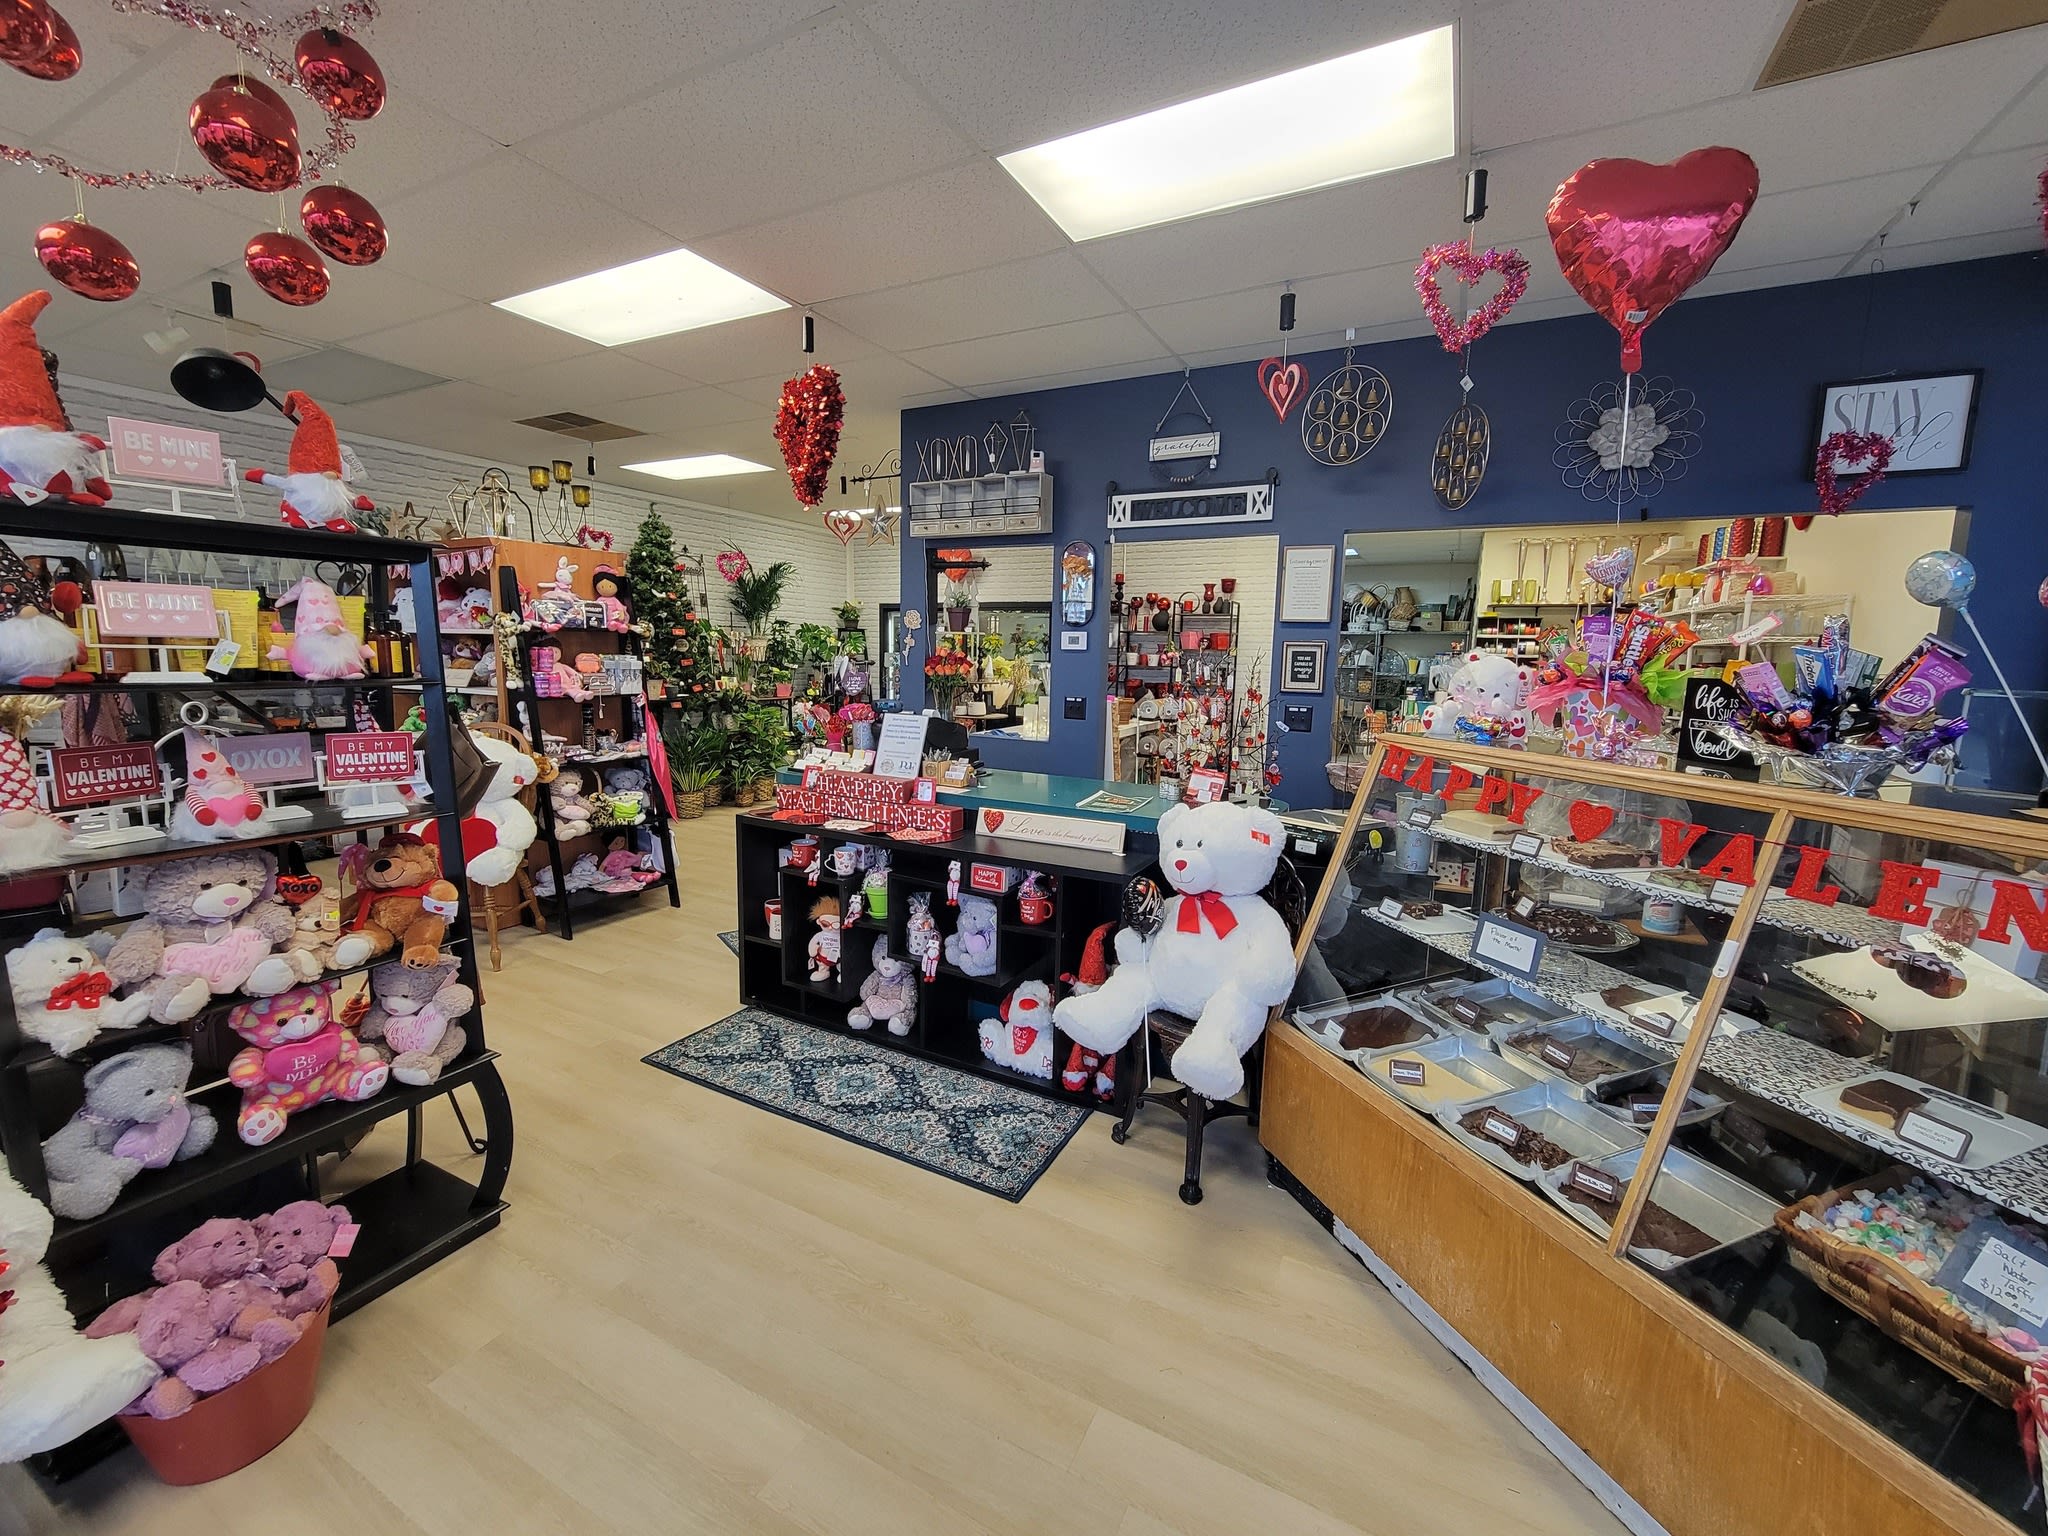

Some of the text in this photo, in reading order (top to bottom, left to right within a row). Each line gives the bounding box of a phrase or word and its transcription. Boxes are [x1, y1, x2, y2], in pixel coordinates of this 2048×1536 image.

[1834, 386, 1936, 437] STAY
[124, 430, 212, 460] BE MINE
[1154, 437, 1217, 456] grateful
[1132, 496, 1248, 521] WELCOME
[106, 591, 205, 611] BE MINE
[1622, 624, 1651, 667] Skittle
[1695, 684, 1740, 720] life IS
[347, 740, 394, 752] BE MY
[1695, 730, 1737, 759] bowl
[79, 753, 135, 769] BE MY
[335, 751, 407, 766] VALENTINE
[65, 764, 152, 787] VALENTINE
[1380, 744, 1545, 826] HAPPY
[819, 775, 901, 802] HAPPY
[778, 790, 948, 830] VALENTINES
[1004, 815, 1043, 836] Love
[977, 869, 998, 878] HAPPY
[282, 882, 319, 894] XOXO
[292, 1054, 318, 1071] Be
[1915, 1129, 1947, 1145] CHOCOLATE
[1934, 1131, 1955, 1143] BUTTER
[1993, 1243, 2027, 1268] Salt
[2002, 1262, 2037, 1287] Water
[2000, 1274, 2036, 1304] Taffy
